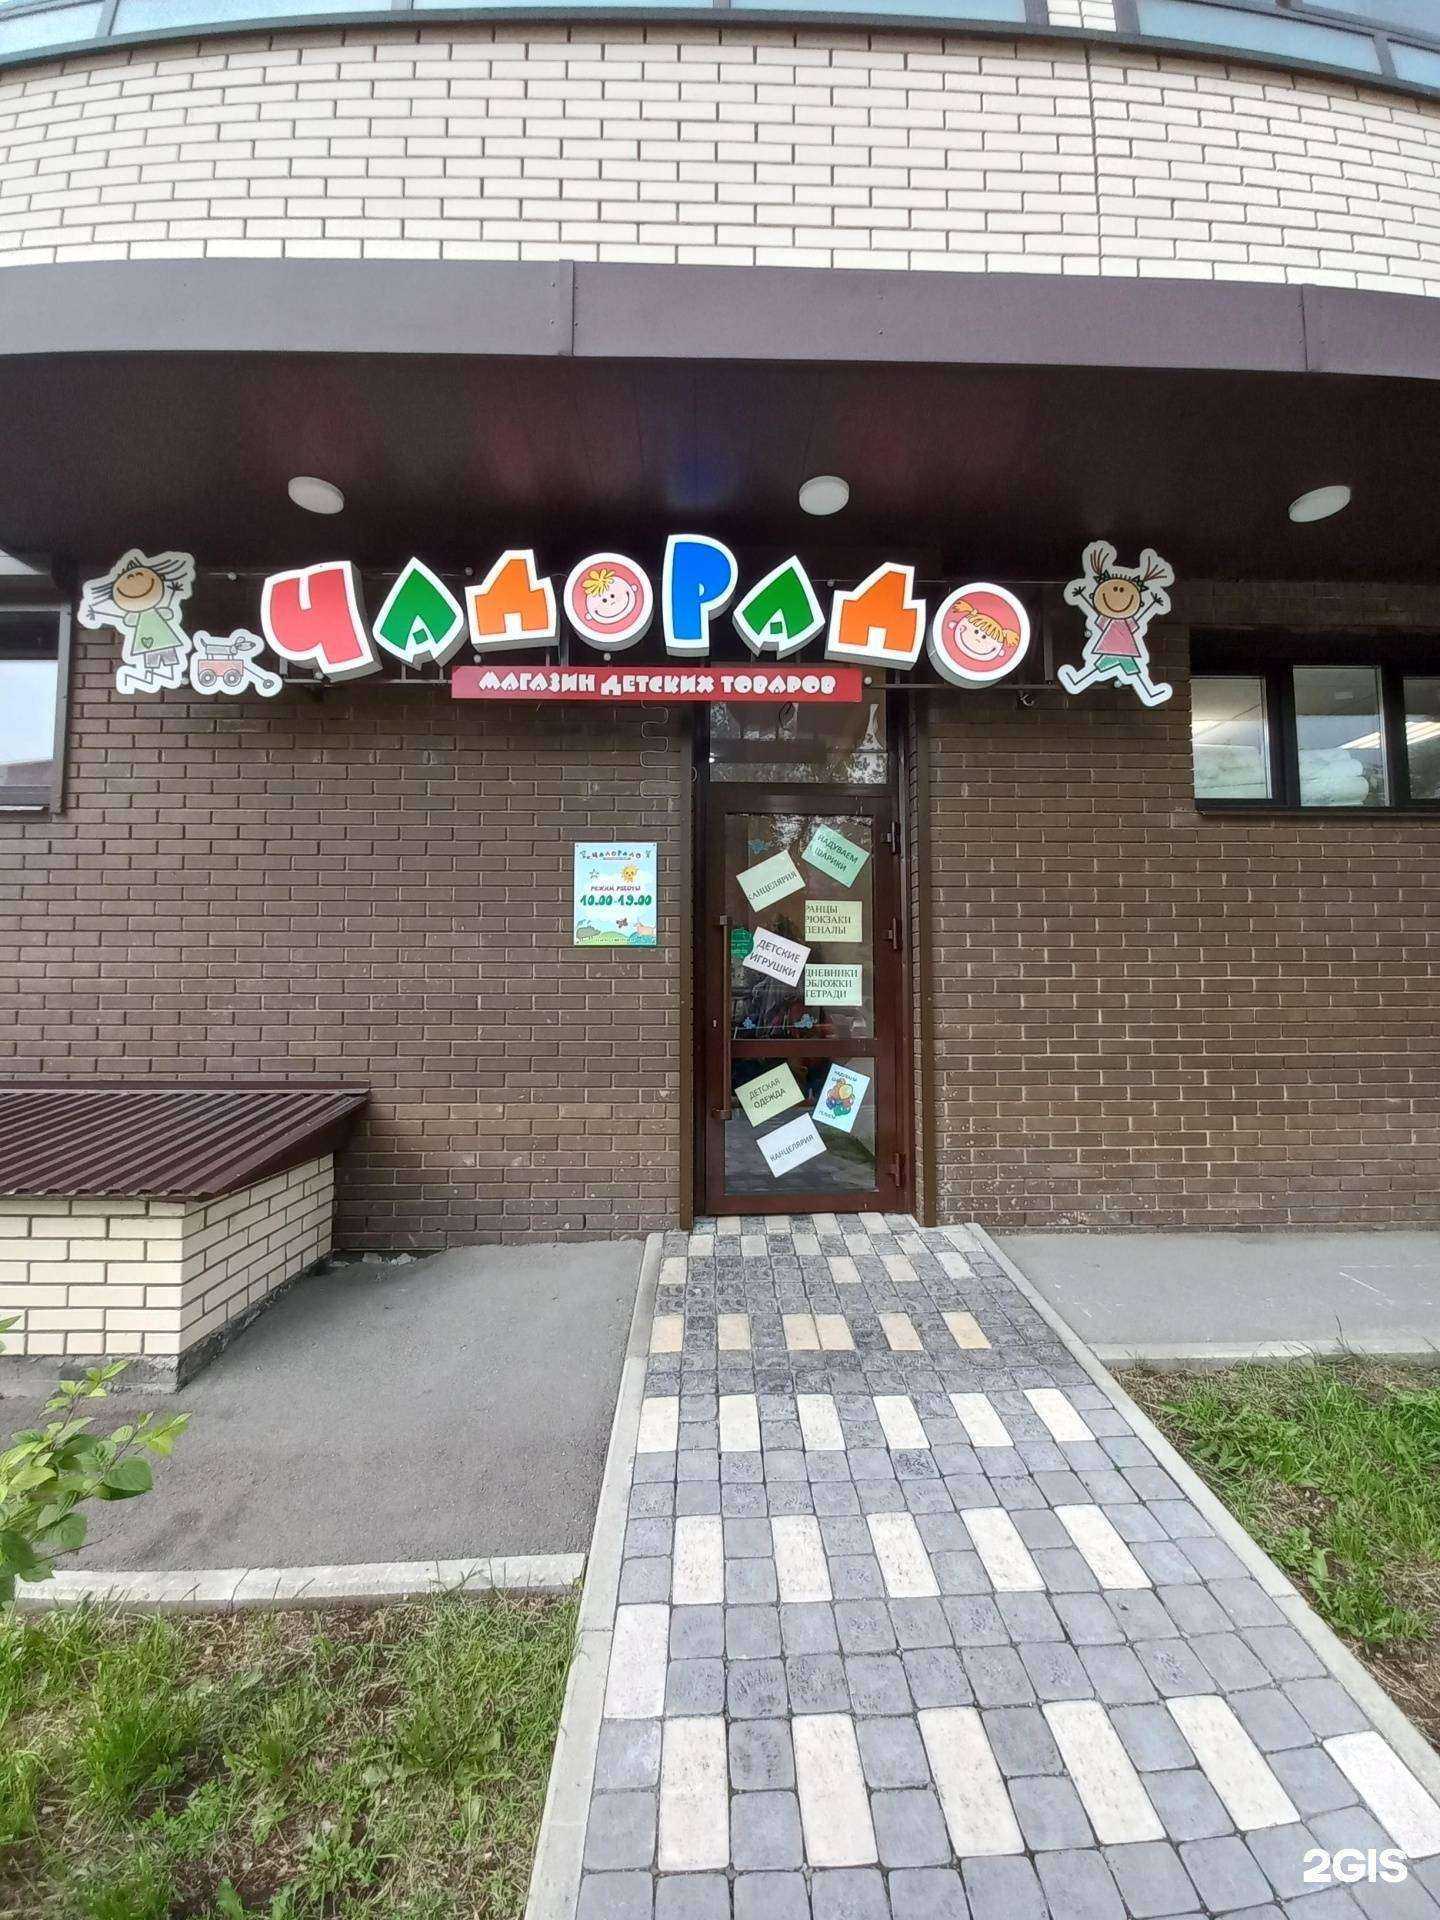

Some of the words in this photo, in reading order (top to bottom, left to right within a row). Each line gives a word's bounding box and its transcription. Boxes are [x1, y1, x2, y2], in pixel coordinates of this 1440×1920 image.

[478, 671, 595, 692] МАГАЗИН
[601, 674, 715, 696] ДЕТСКИХ
[721, 675, 836, 695] ТОВАРОВ
[815, 847, 847, 872] ШАРИКИ
[818, 834, 858, 864] НАДУВАЕМ
[757, 939, 801, 963] ДЕТСКИЕ
[750, 952, 796, 977] ИГРУШКИ
[749, 1078, 781, 1101] ДЕТСКАЯ
[753, 1088, 786, 1109] ОДЕЖДА
[770, 1134, 814, 1161] КАНЦЕЛЯРИЯ
